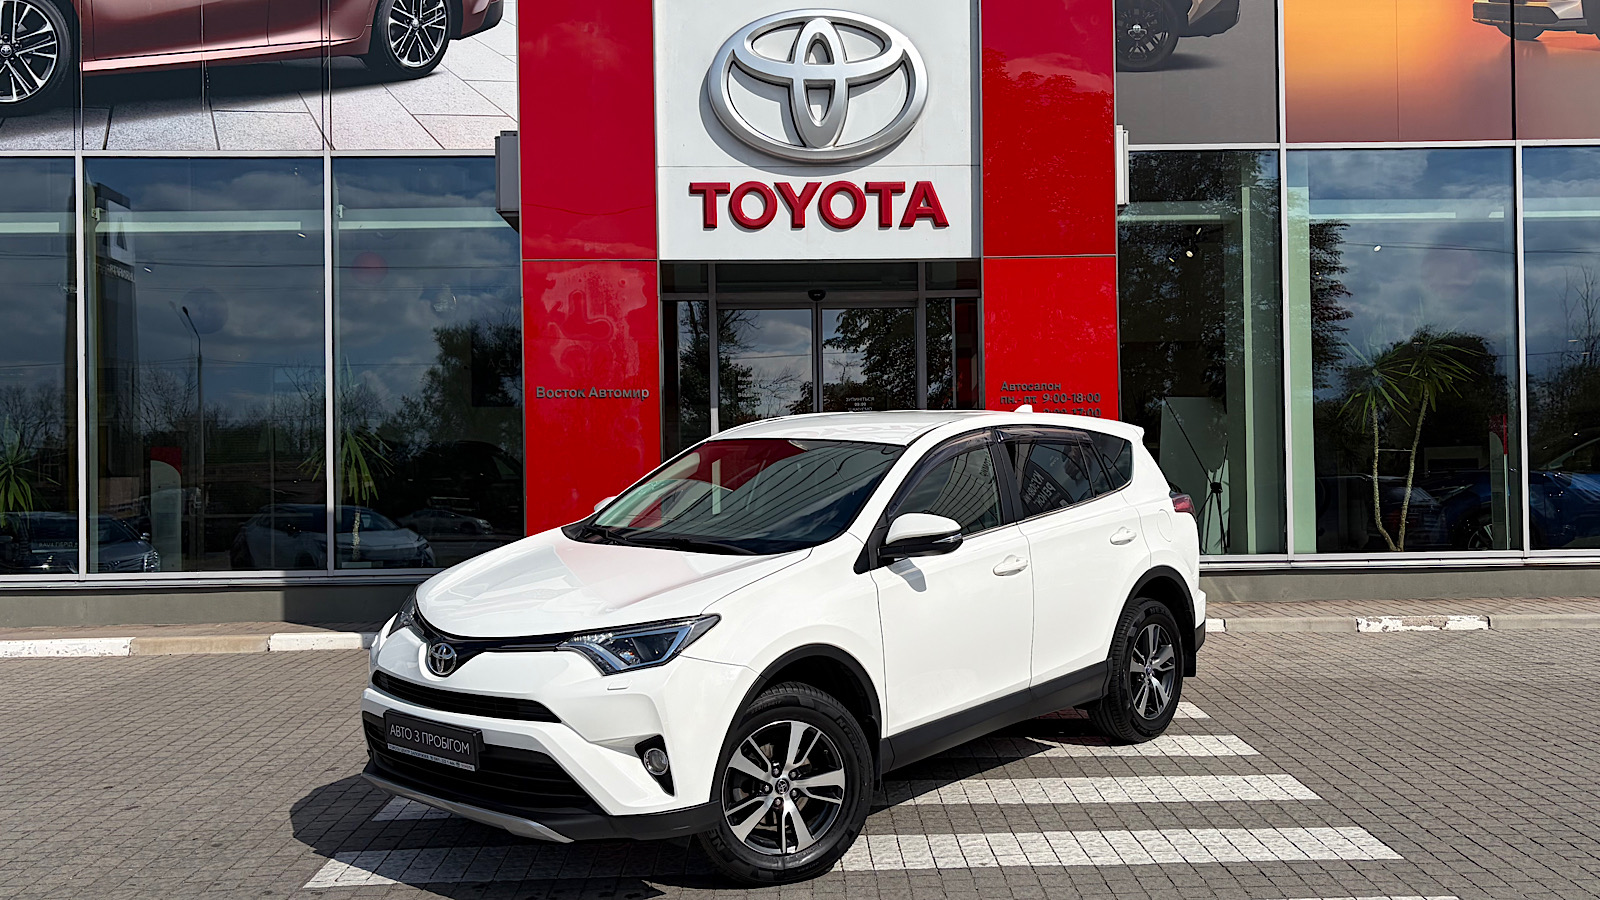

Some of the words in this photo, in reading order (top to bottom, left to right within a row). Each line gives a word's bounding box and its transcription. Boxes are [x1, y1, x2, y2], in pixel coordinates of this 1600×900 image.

[689, 181, 950, 230] TOYOTA
[536, 386, 586, 399] Восток
[588, 386, 650, 401] Автомир
[1000, 381, 1061, 391] Автосалон
[1042, 393, 1101, 403] 9:00-18:00
[390, 724, 413, 740] АВТО
[414, 730, 420, 743] З
[422, 731, 470, 755] ПРОБІГОМ
